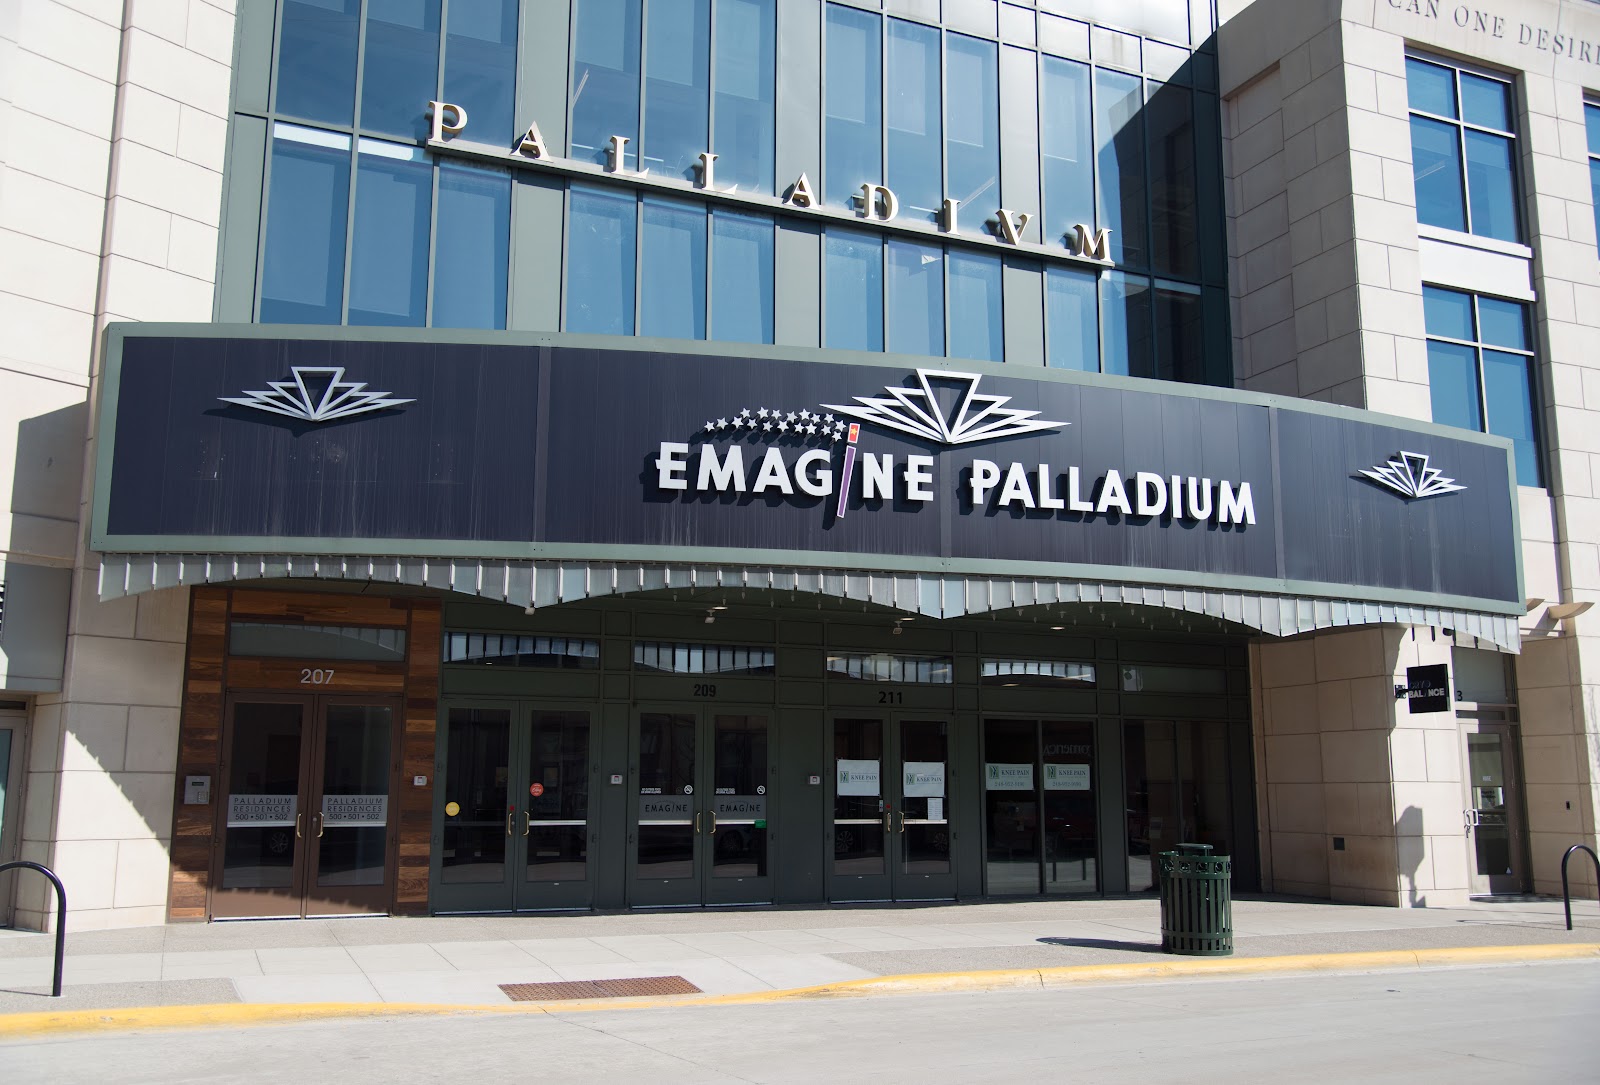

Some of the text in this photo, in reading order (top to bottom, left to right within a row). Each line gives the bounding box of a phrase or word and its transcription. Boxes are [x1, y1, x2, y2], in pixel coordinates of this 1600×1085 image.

[1454, 6, 1505, 38] ONE
[971, 459, 1256, 526] PALLADIUM
[300, 668, 335, 685] 207
[694, 684, 717, 697] 209
[878, 691, 904, 704] 211
[234, 797, 292, 805] PALLADIUM
[233, 805, 291, 813] RESIDENCES
[327, 805, 382, 813] RESIDENCES
[645, 804, 688, 813] EMAGINE
[719, 804, 761, 813] EMAGINE
[235, 813, 288, 821] 500 501 502
